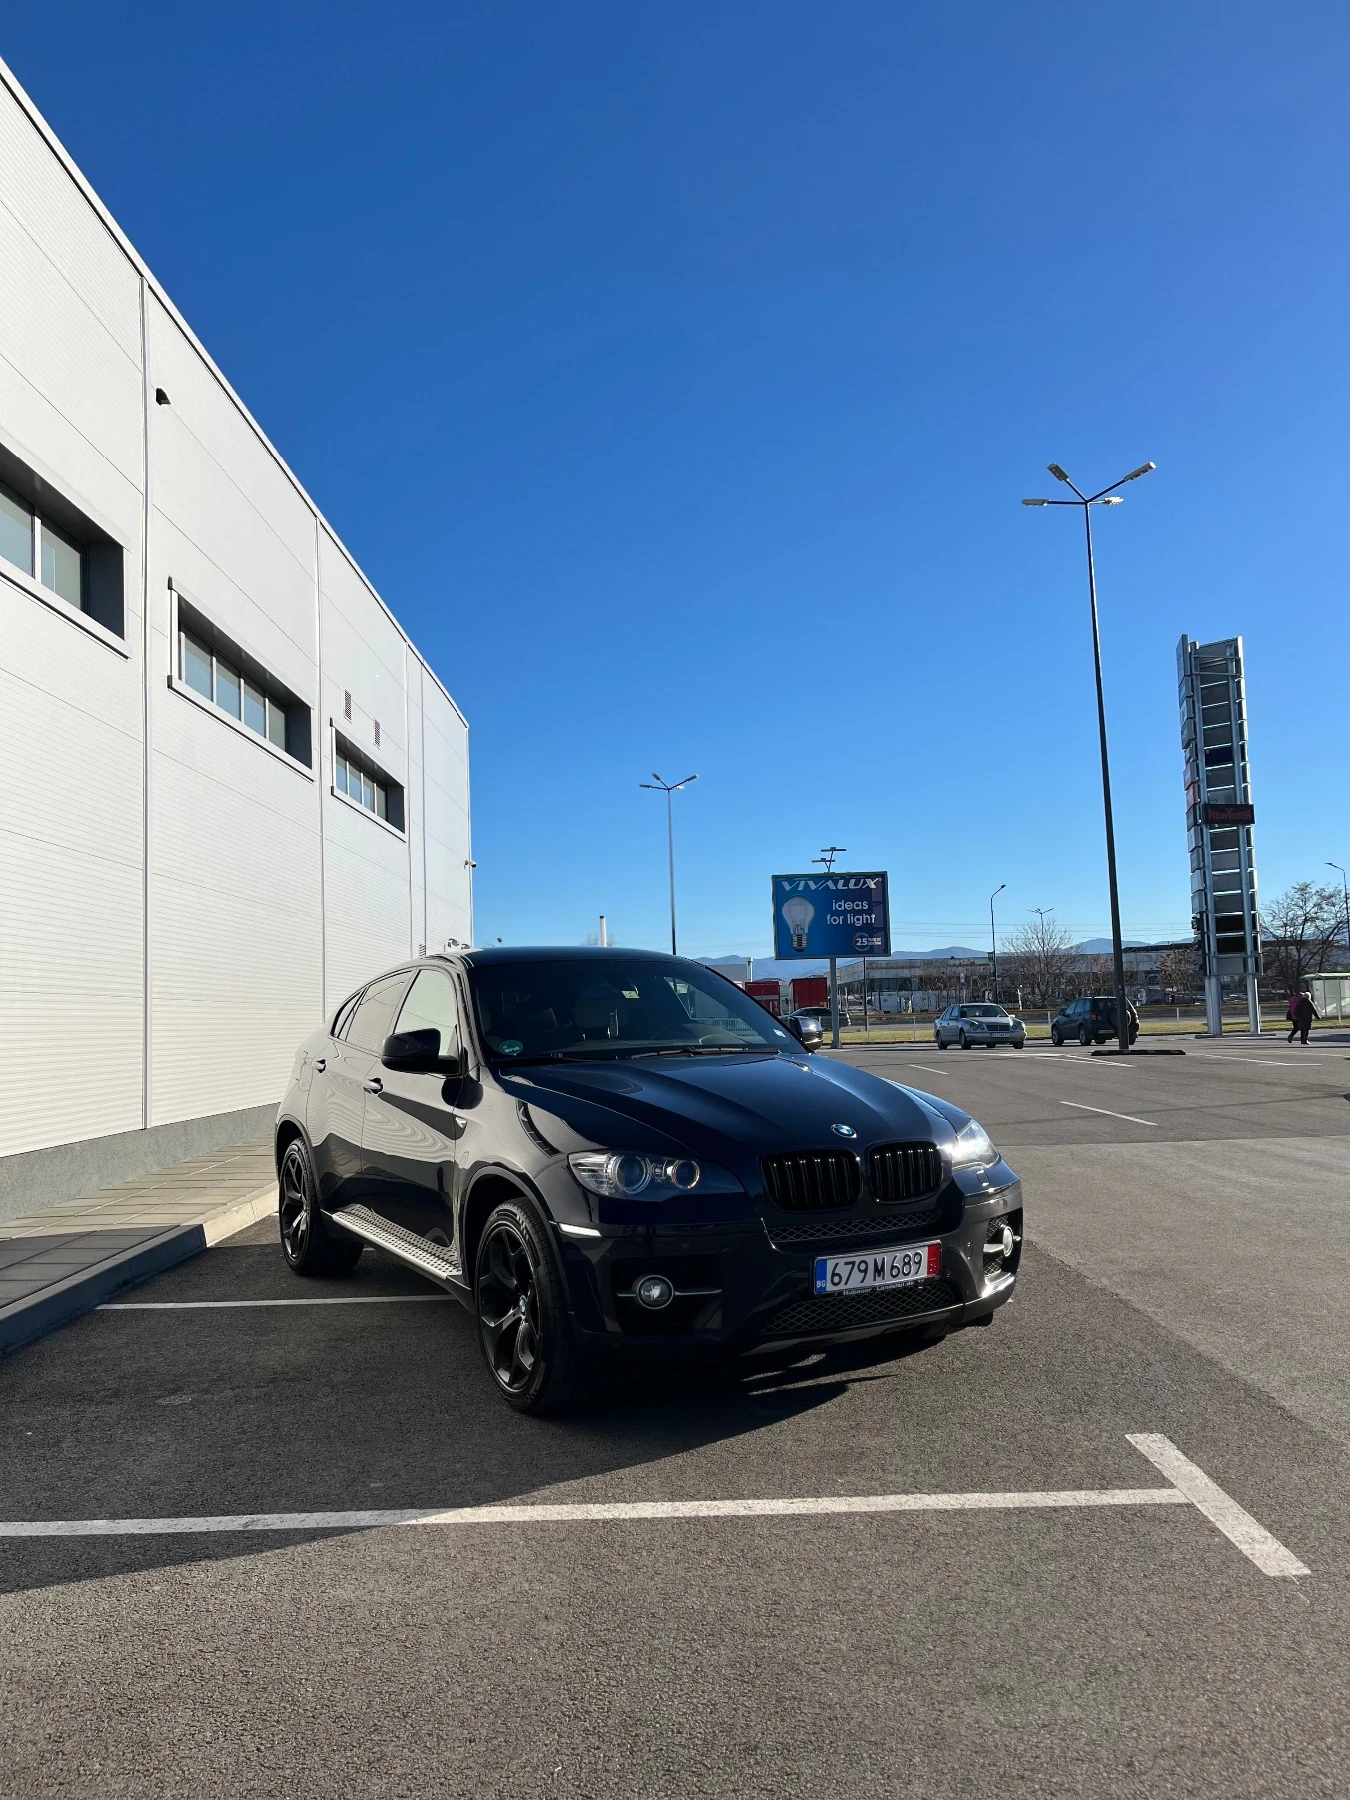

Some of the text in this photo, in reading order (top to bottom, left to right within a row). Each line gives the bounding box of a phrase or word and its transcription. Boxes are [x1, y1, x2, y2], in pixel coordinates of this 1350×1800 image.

[781, 878, 879, 891] VIVALUX
[832, 900, 869, 911] ideas
[826, 914, 876, 927] for light
[856, 937, 868, 946] 25
[816, 1279, 826, 1288] BG
